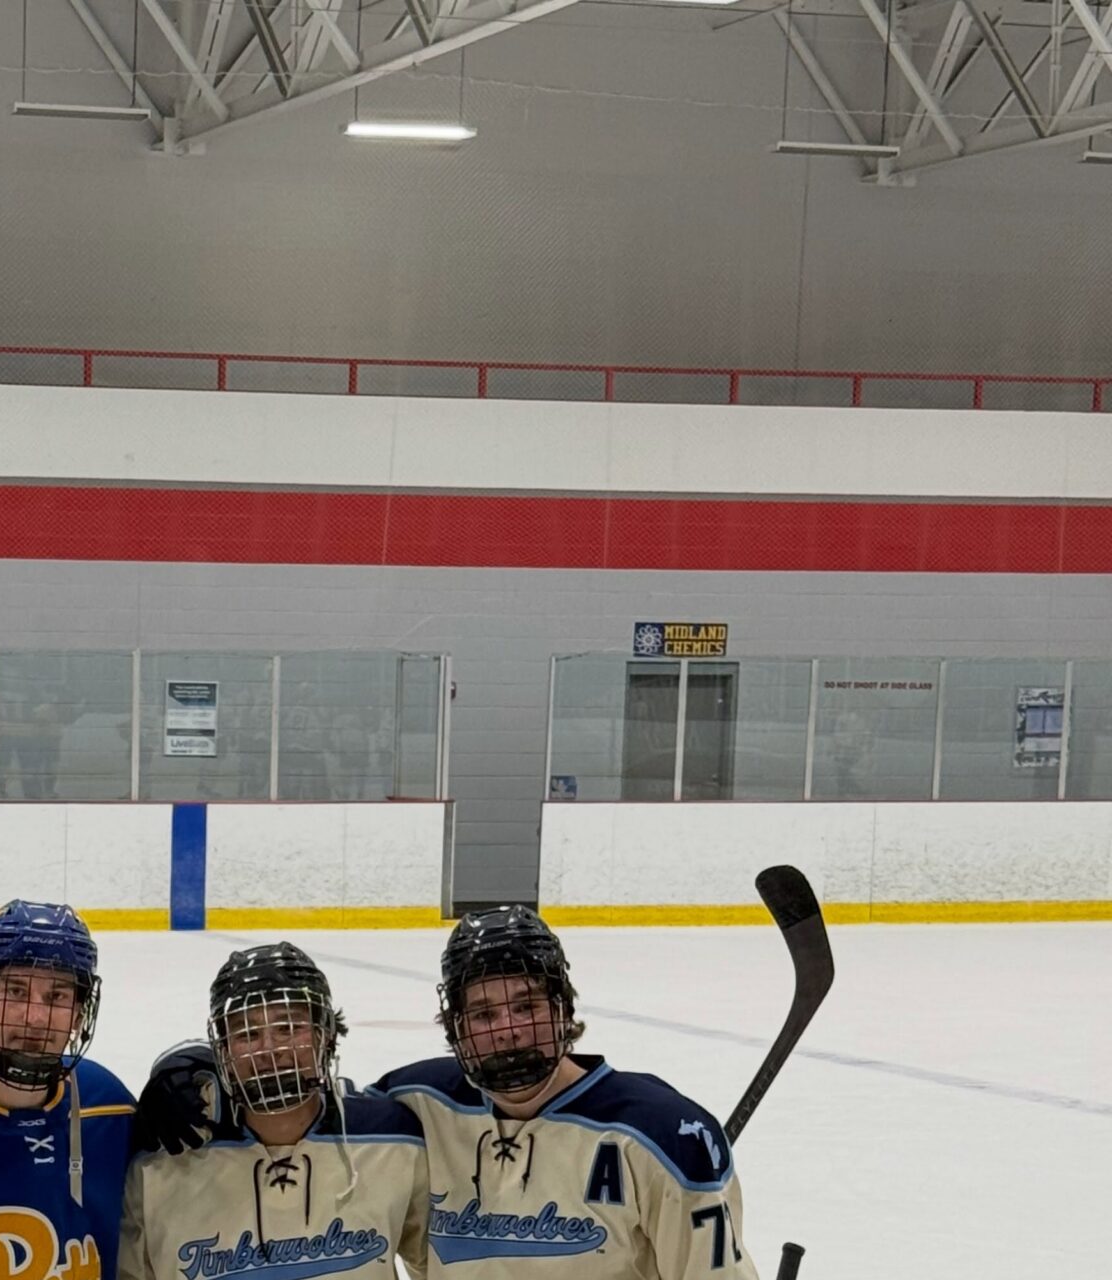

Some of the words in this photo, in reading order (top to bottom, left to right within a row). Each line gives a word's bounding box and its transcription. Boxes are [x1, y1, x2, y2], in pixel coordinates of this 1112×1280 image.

[664, 625, 726, 640] MIDLAND
[664, 641, 724, 655] CHEMICS
[824, 681, 835, 689] DO
[837, 681, 852, 689] NOT
[853, 681, 878, 689] SHOOT
[880, 682, 889, 690] AT
[909, 682, 932, 690] GLASS
[583, 1141, 626, 1206] A
